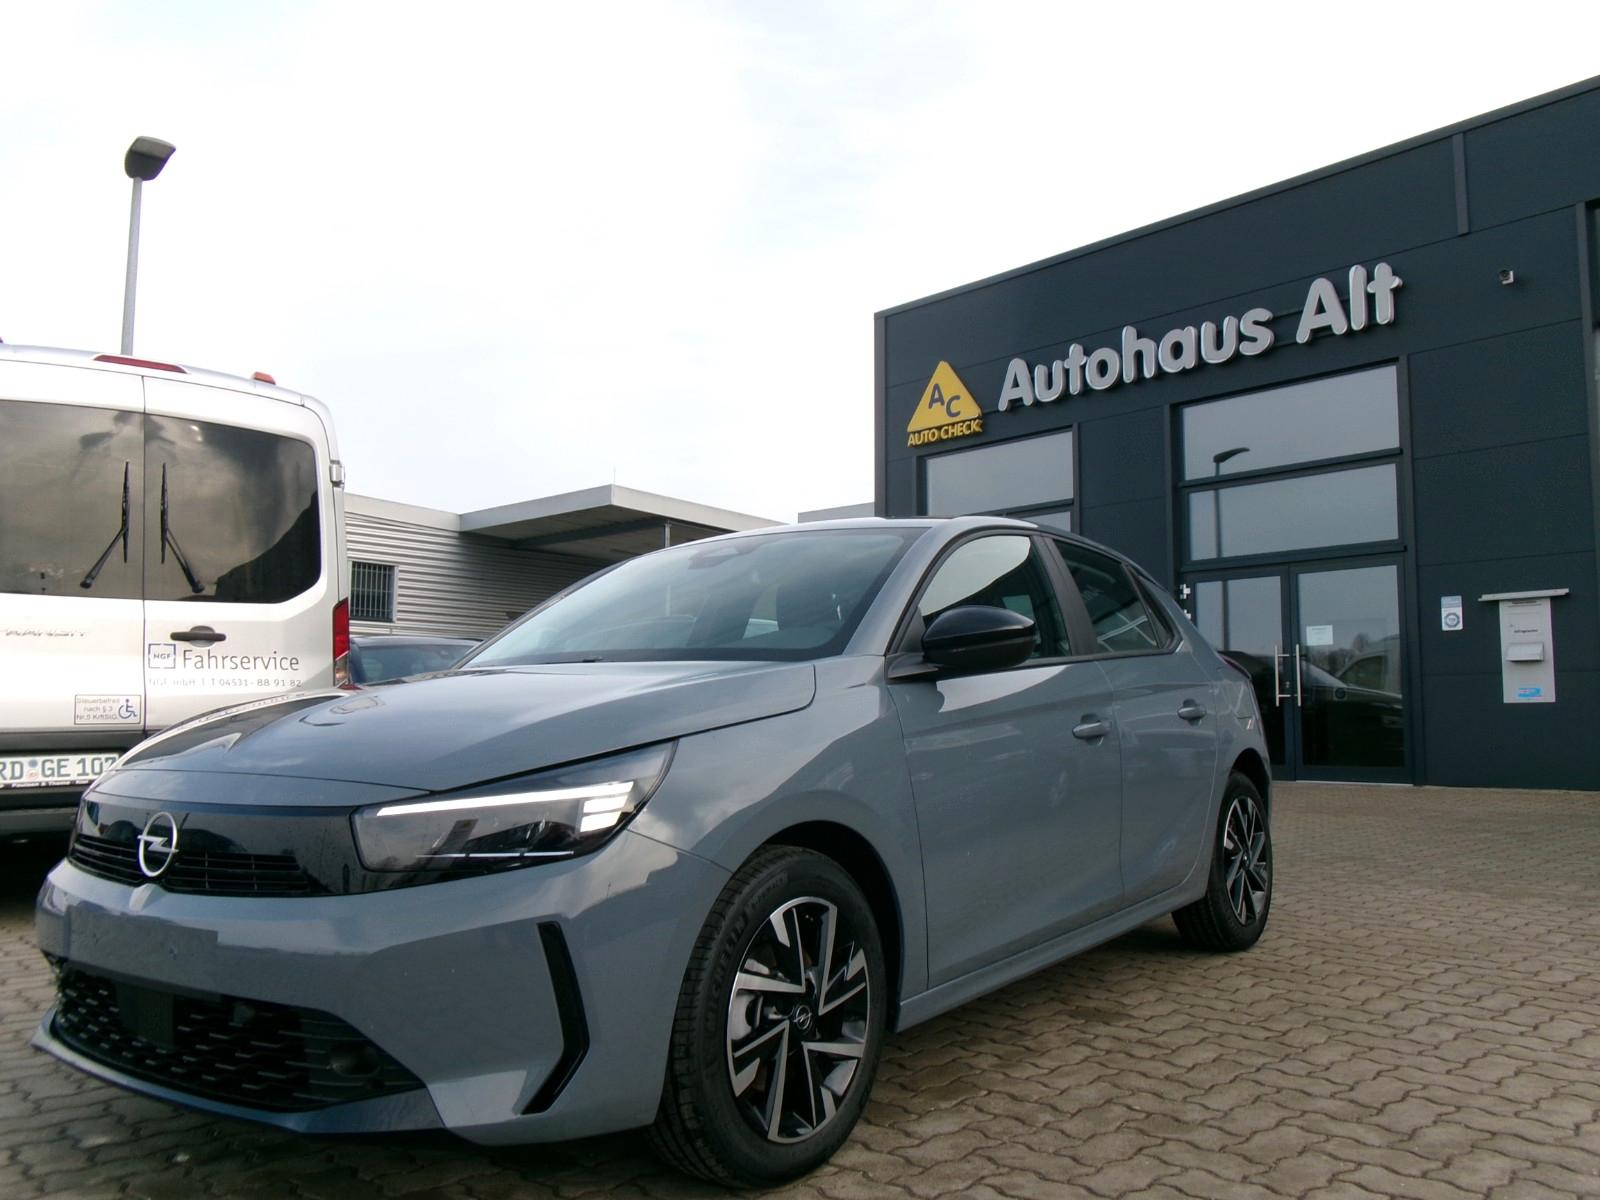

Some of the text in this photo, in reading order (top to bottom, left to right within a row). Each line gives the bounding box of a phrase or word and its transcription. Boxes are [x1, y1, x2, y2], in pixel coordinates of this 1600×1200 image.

[999, 262, 1402, 411] Autohaus Alt
[907, 419, 983, 447] AUTO CHECK
[183, 648, 300, 671] Fahrservice
[41, 758, 71, 778] GE
